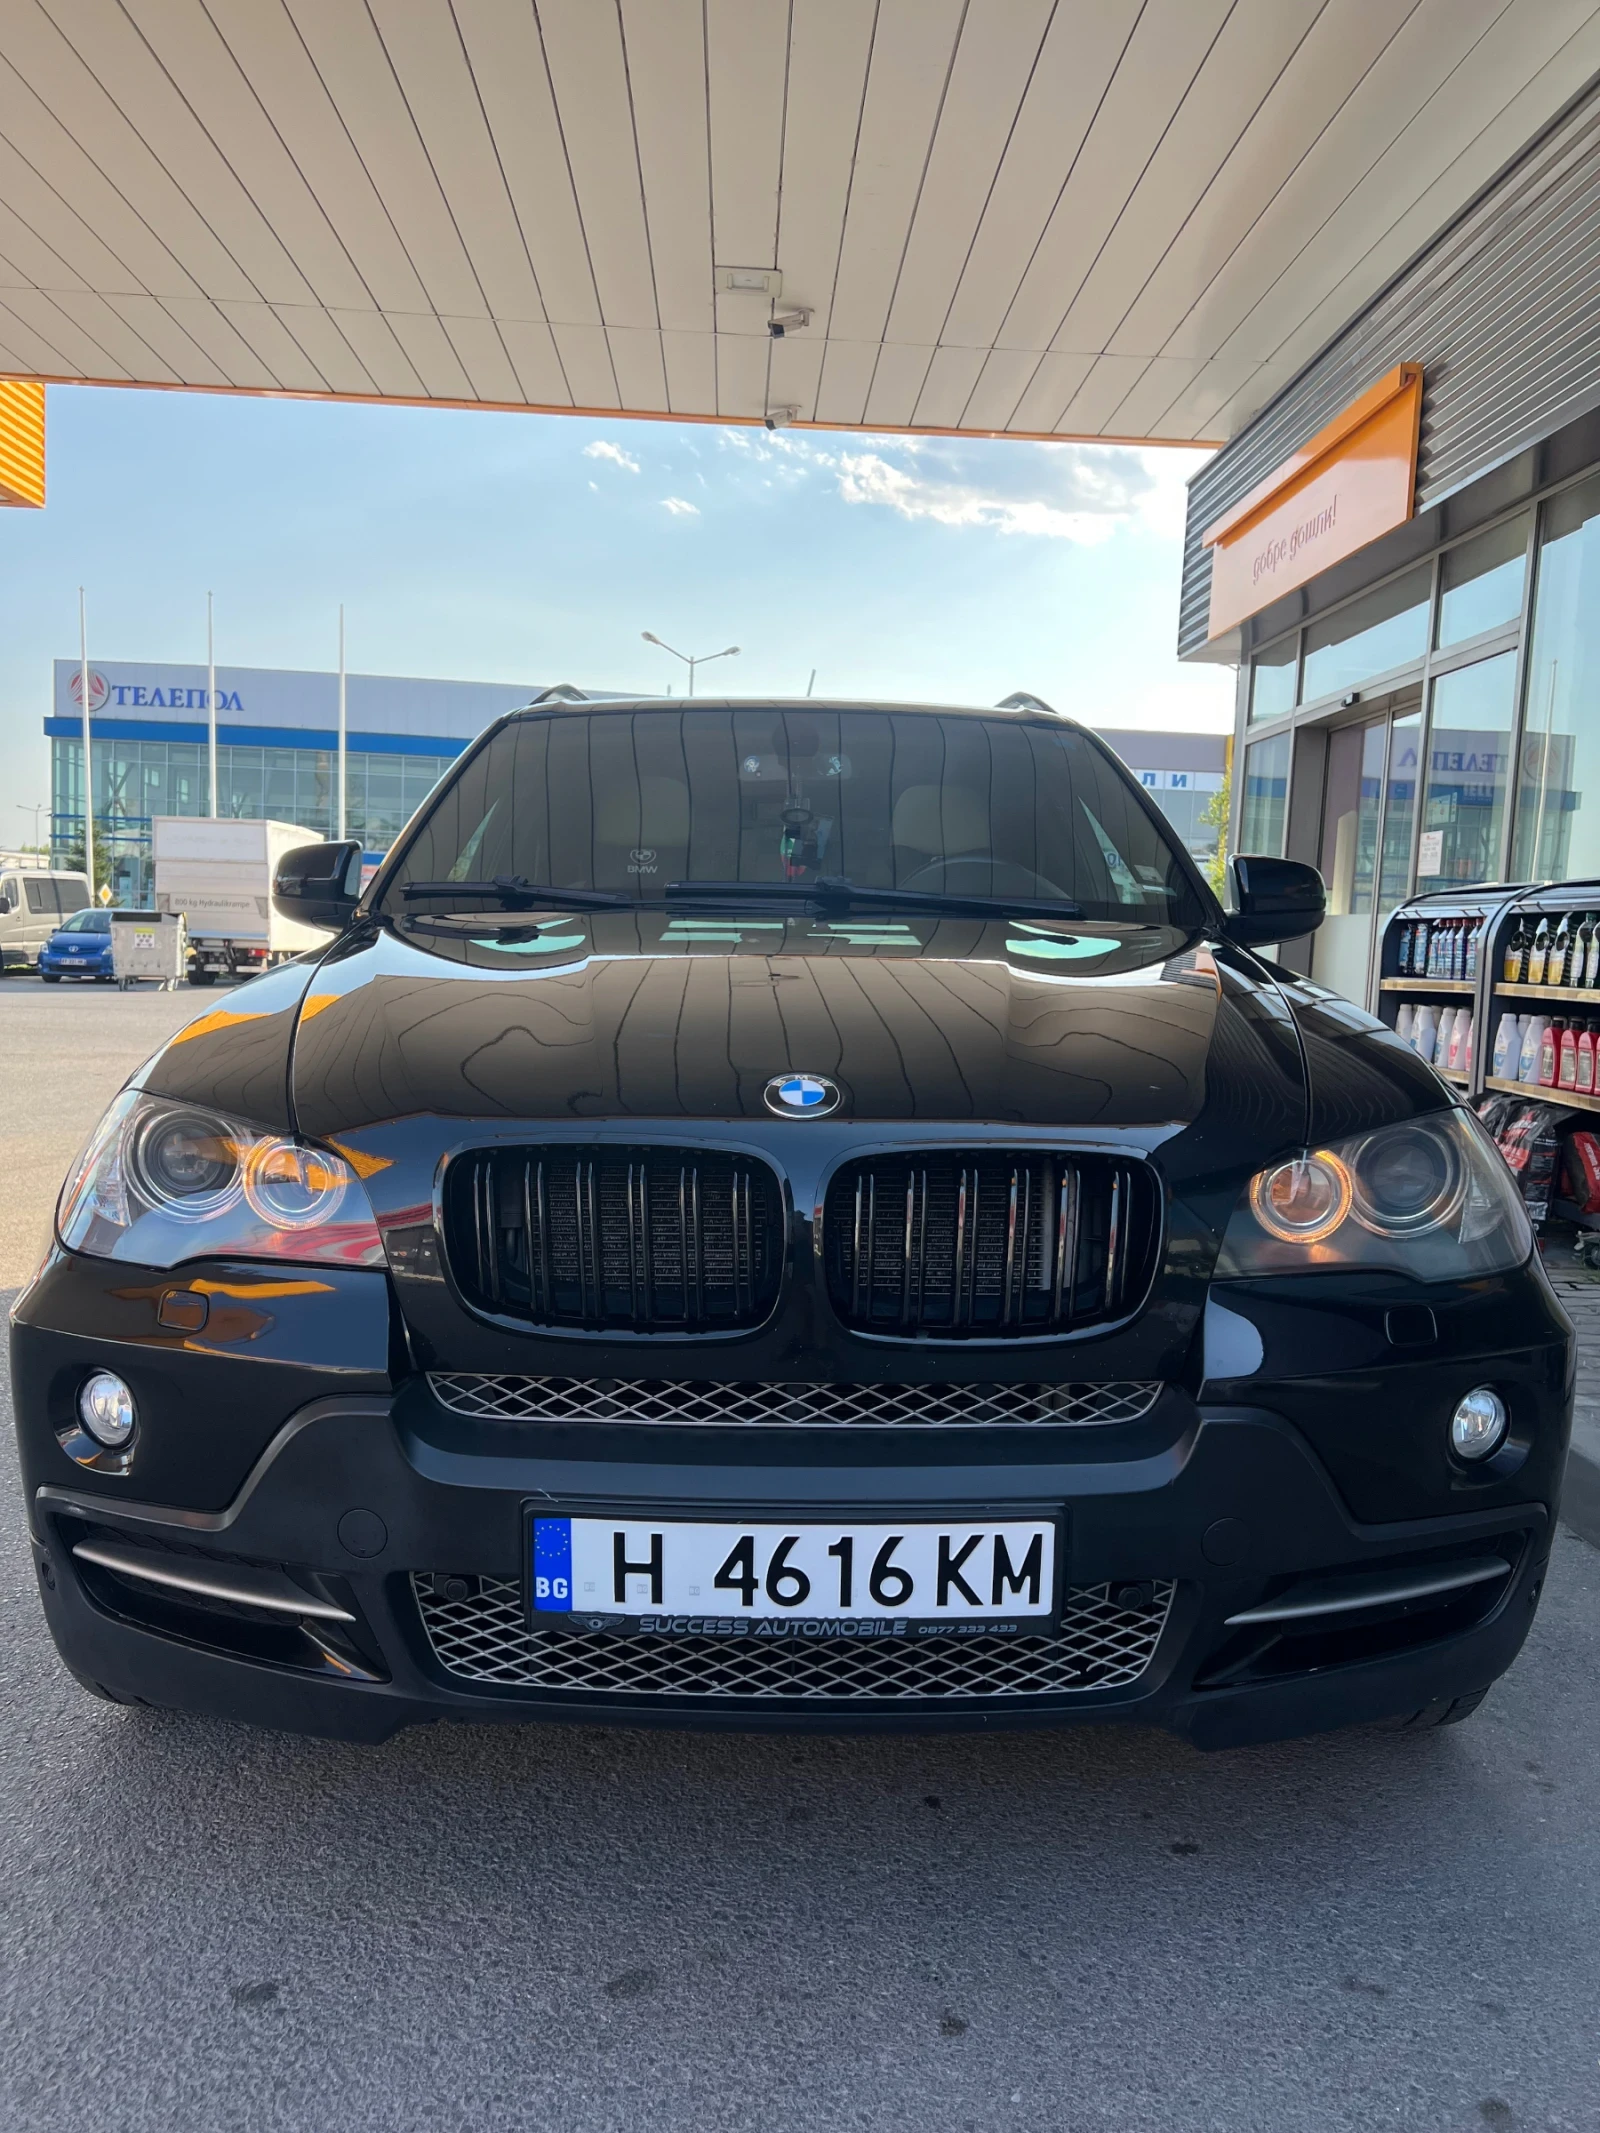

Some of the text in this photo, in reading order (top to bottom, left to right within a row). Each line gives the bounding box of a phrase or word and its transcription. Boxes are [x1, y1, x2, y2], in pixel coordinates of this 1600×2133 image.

[1253, 493, 1338, 586] добре дошли!
[111, 684, 245, 712] ТЕЛЕПОЛ
[627, 865, 658, 874] BMW
[188, 899, 198, 908] kg
[199, 900, 251, 909] Hydraulikrampe
[613, 1531, 1043, 1608] H 4616 KM
[536, 1576, 568, 1599] BG
[638, 1617, 1018, 1637] SUCCESS AUTOMOBILE 0877 333 433
